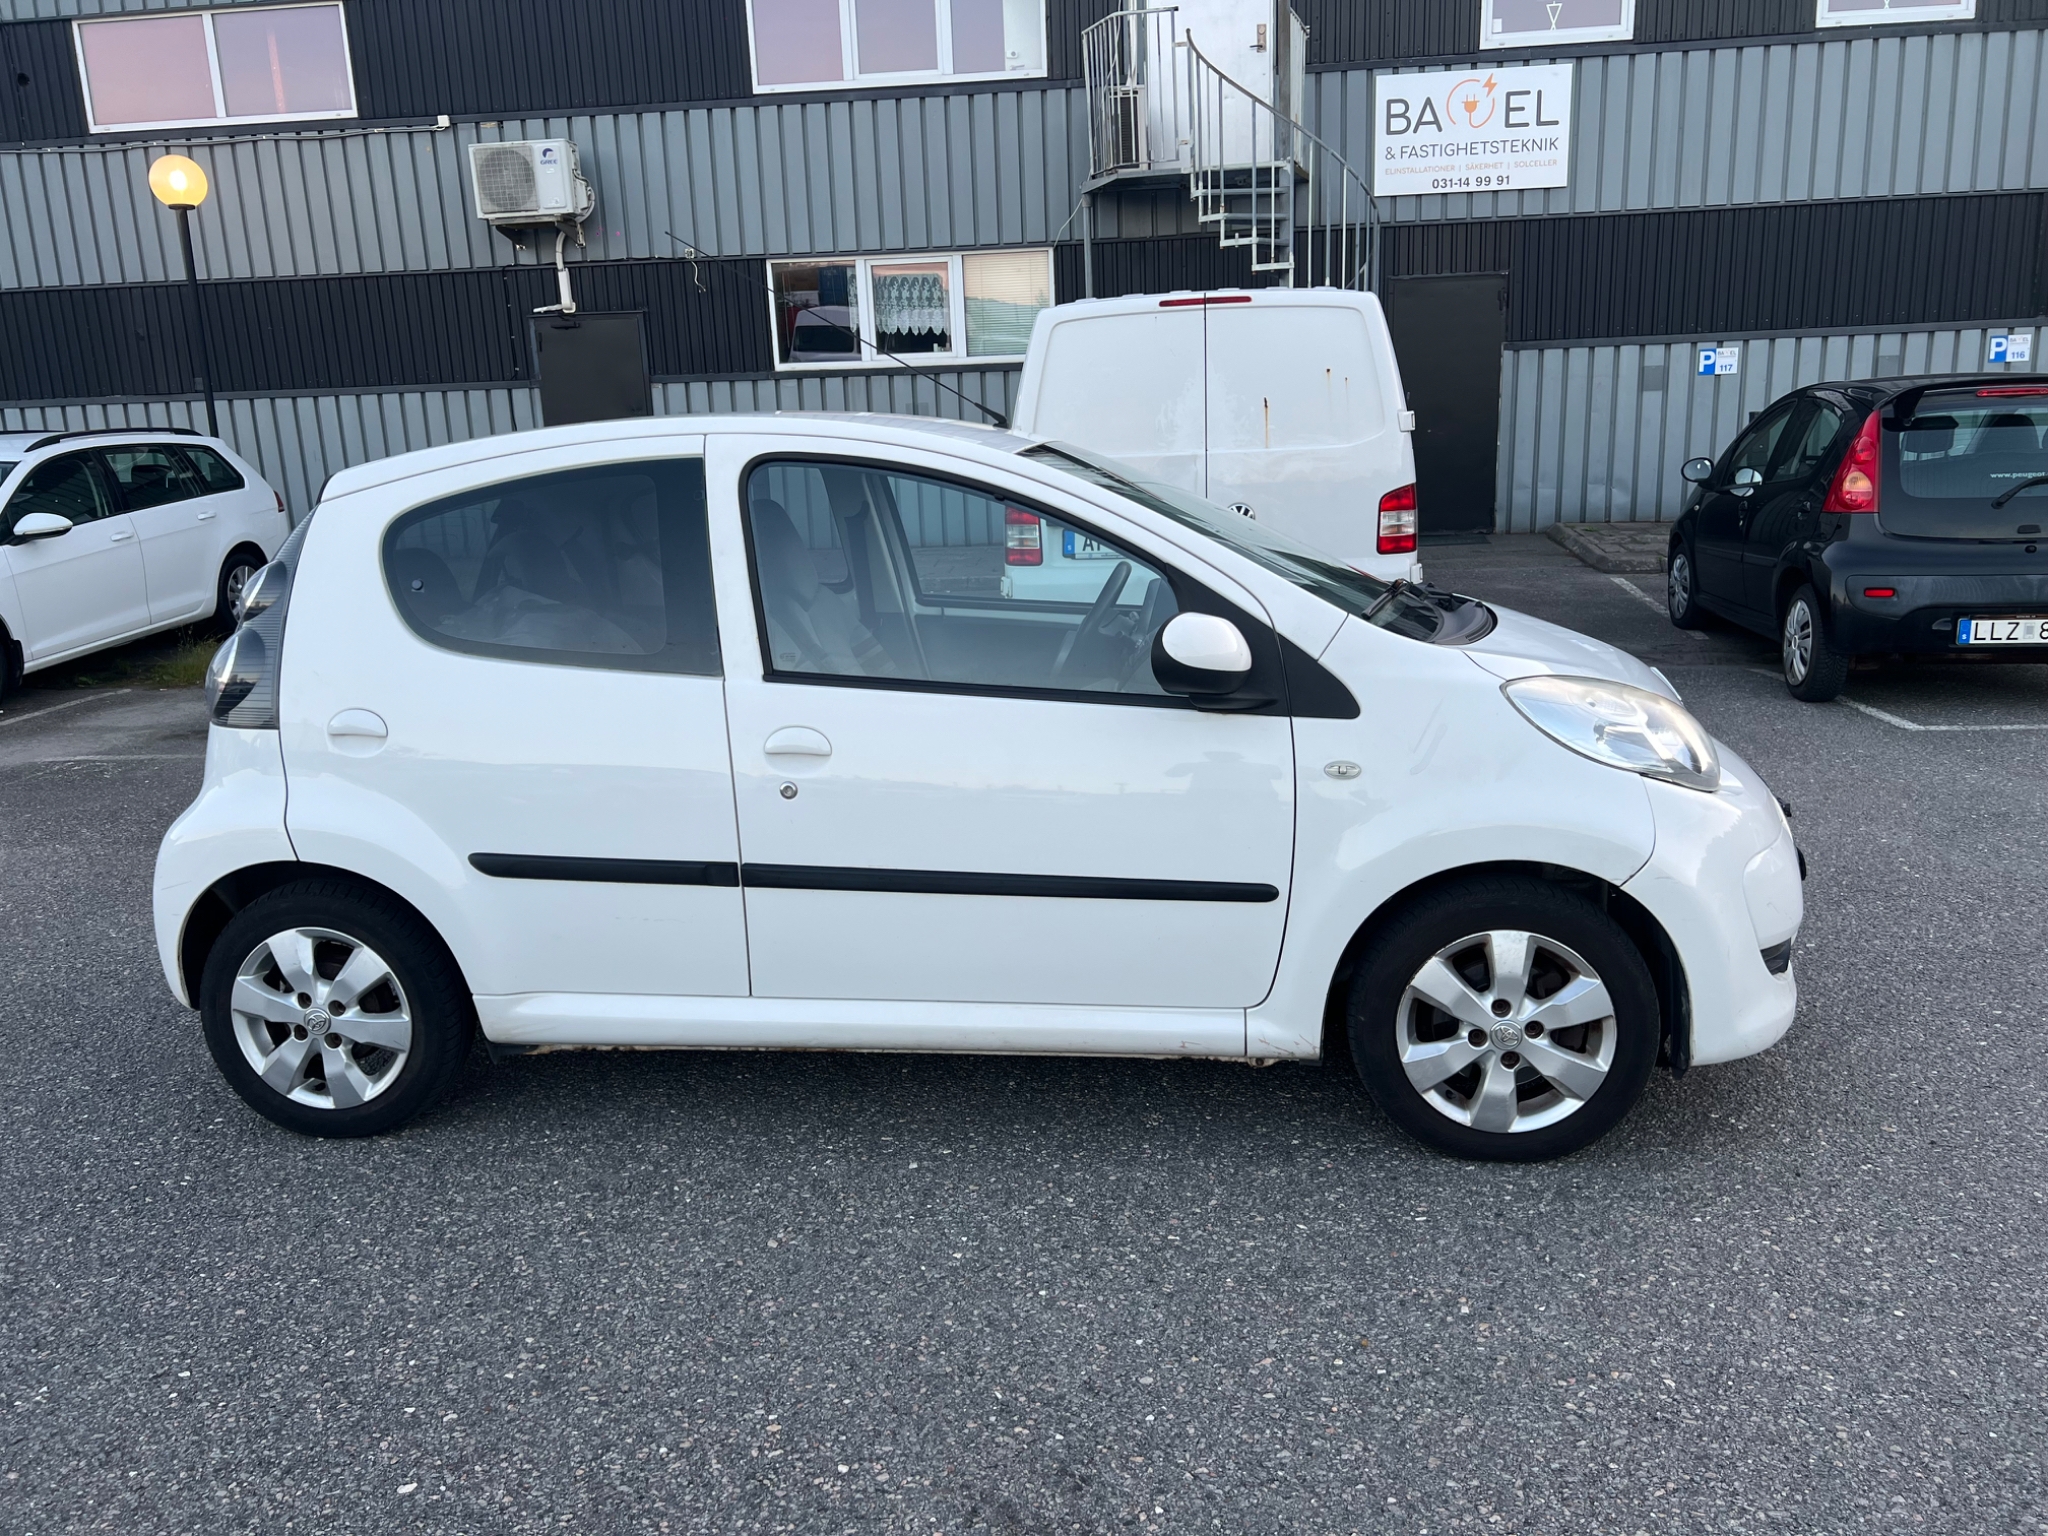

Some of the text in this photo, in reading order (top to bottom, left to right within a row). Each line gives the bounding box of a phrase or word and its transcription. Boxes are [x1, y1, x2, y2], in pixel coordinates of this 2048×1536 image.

[1385, 137, 1559, 160] & FASTIGHETSTEKNIK
[1385, 159, 1558, 175] ELINSTALLATIONER SÄKERHET SOLCELLER
[1431, 174, 1510, 189] 031-14 99 91
[1990, 338, 2008, 359] P
[2011, 351, 2025, 359] 116
[1699, 351, 1716, 372] P
[1720, 364, 1733, 372] 117
[1974, 622, 2020, 641] LLZ
